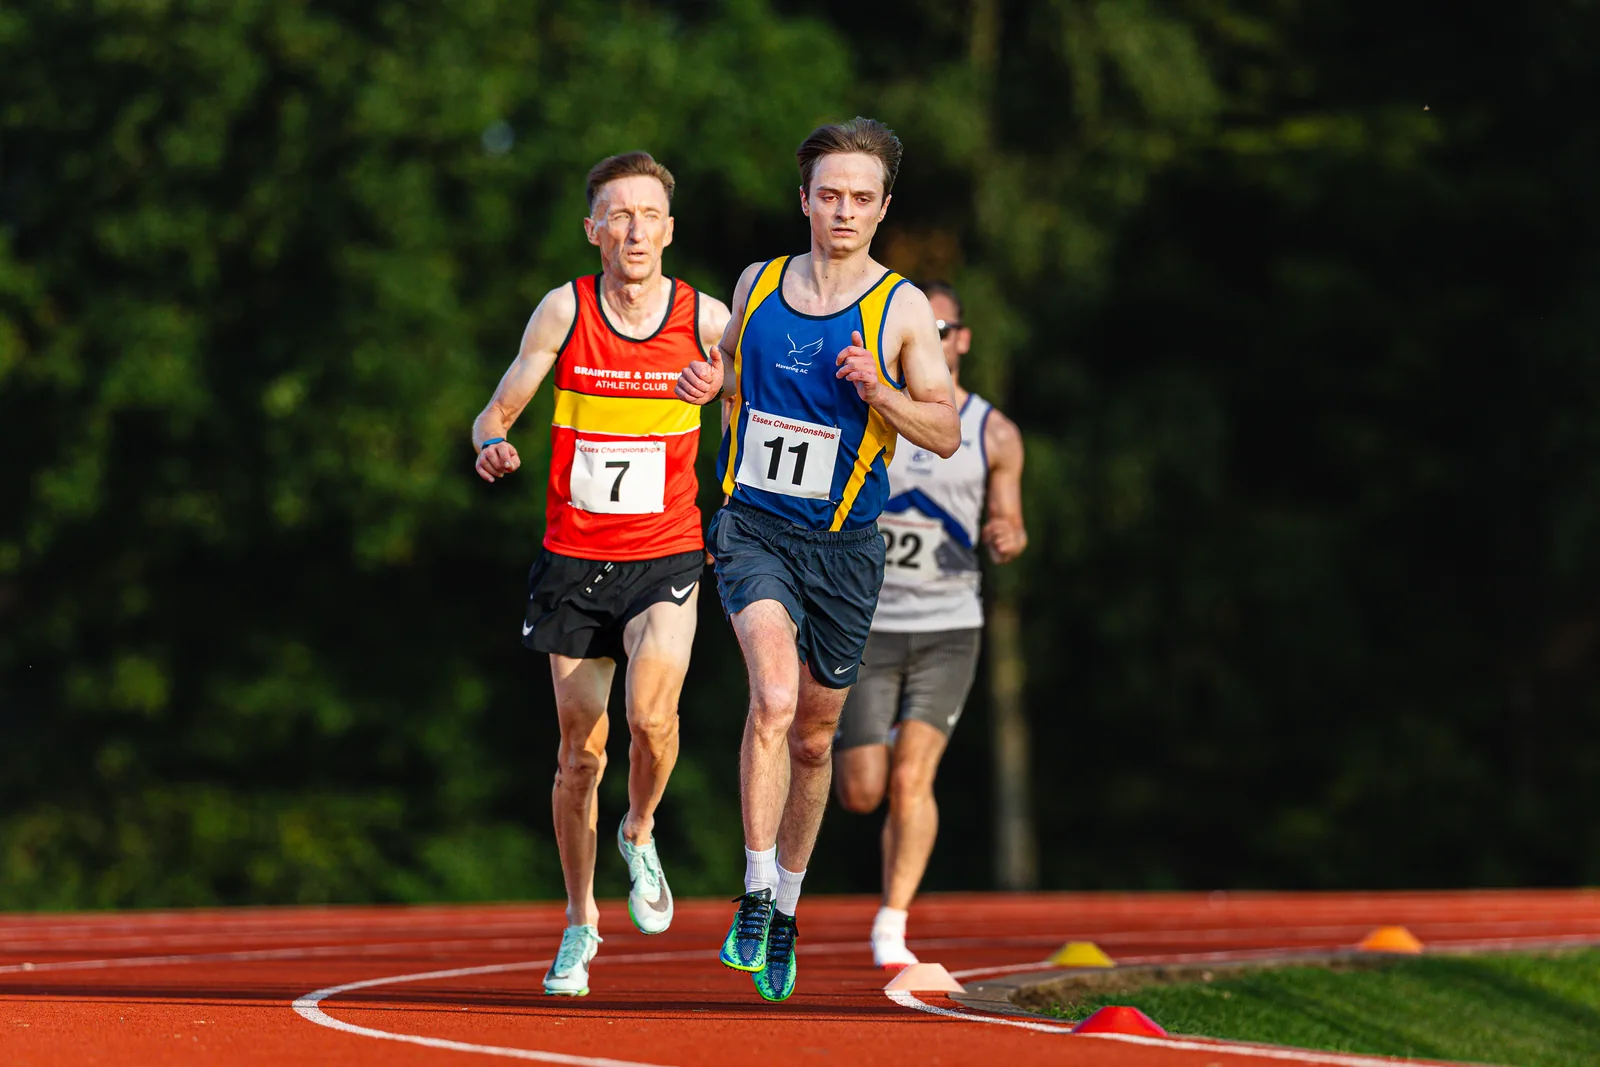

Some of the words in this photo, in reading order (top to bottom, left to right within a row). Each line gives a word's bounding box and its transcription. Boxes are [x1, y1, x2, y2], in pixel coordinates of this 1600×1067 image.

[574, 366, 631, 379] BRAINTREE
[633, 371, 642, 379] &
[595, 380, 640, 390] ATHLETIC
[642, 382, 668, 391] CLUB
[751, 414, 772, 426] Essex
[773, 420, 836, 440] Championships
[579, 445, 599, 454] Essex
[601, 446, 660, 454] Championships
[763, 436, 809, 487] 11
[605, 461, 630, 502] 7
